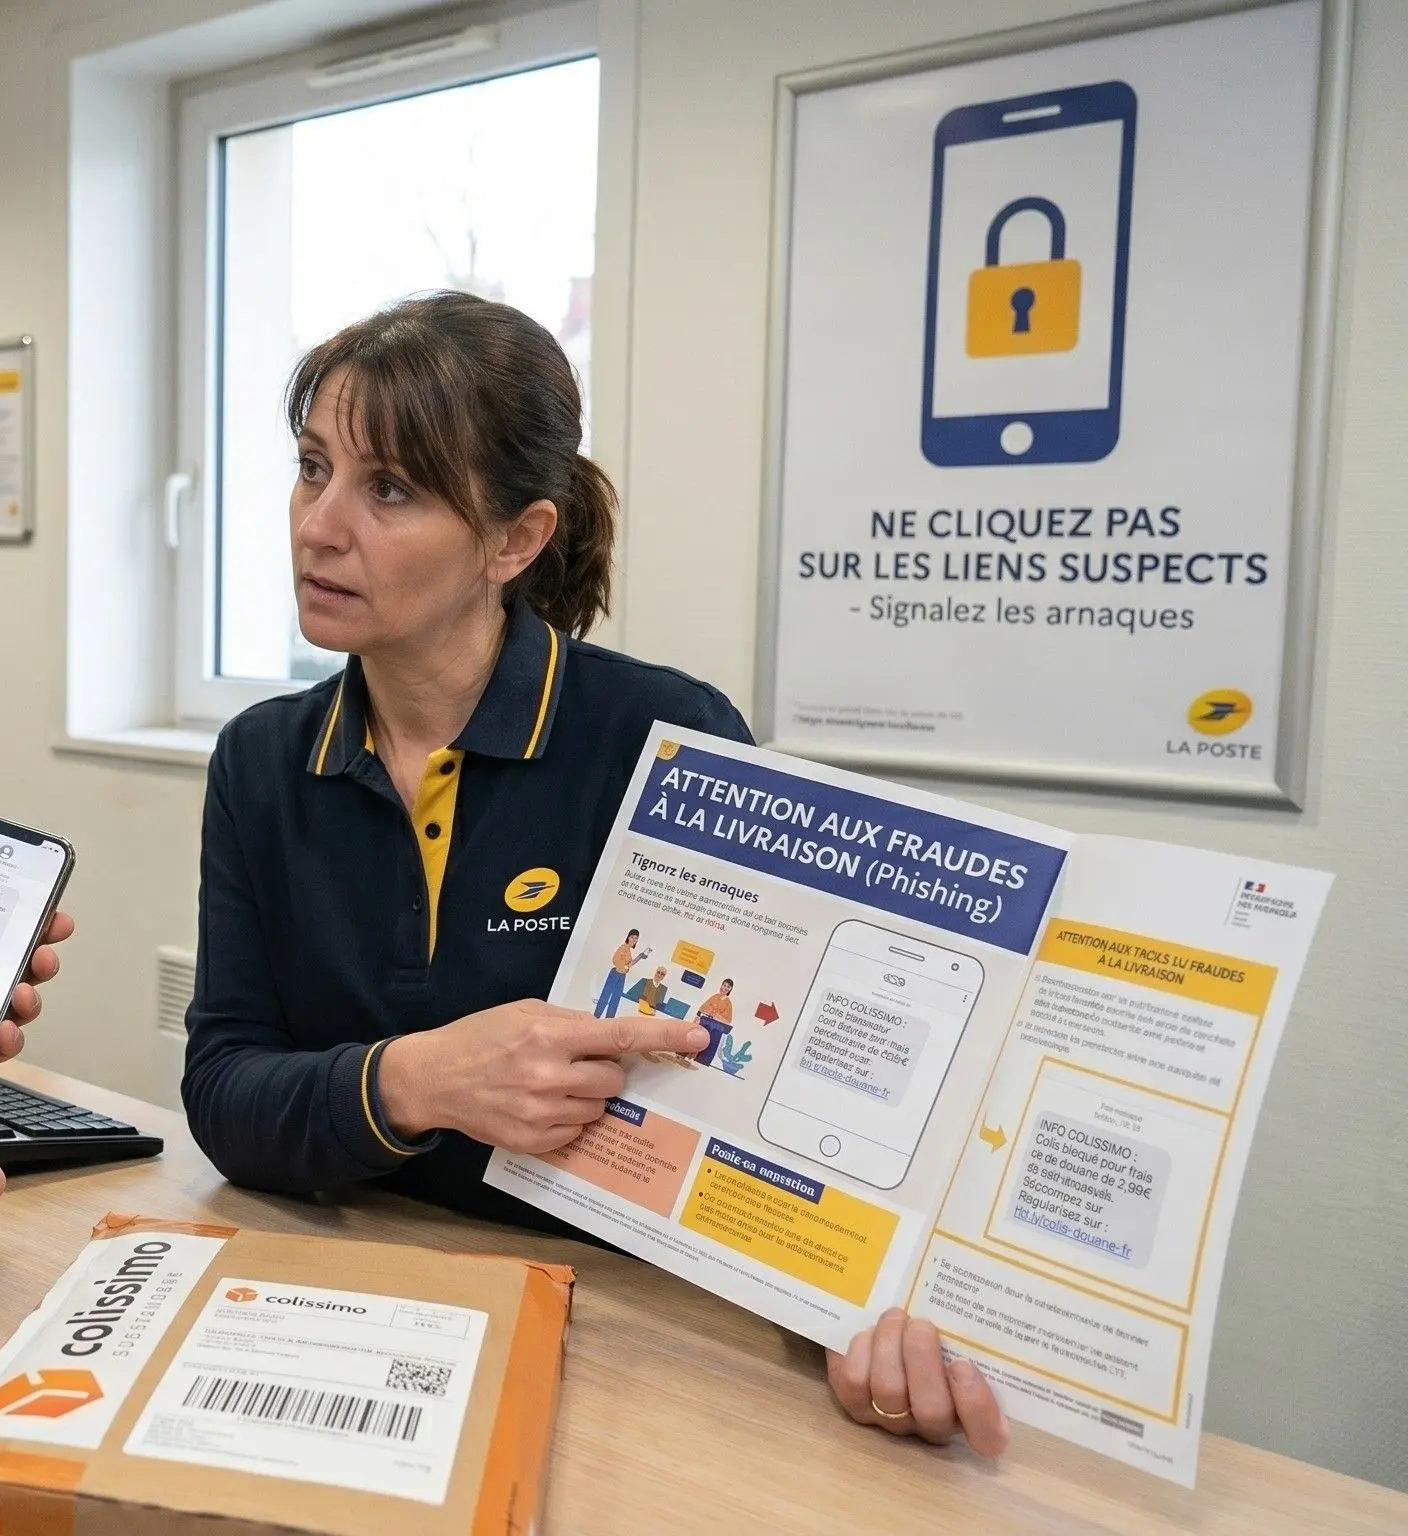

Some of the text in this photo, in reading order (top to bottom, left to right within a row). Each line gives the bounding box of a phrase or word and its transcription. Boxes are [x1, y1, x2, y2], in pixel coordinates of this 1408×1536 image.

[871, 506, 1181, 543] NE CLIQUEZ PAS
[799, 552, 1268, 584] SUR LES LIENS SUSPECTS
[869, 595, 986, 628] Signalez
[997, 598, 1036, 624] les
[1046, 605, 1194, 635] arnaques
[1167, 740, 1262, 760] LA POSTE
[661, 766, 1029, 890] ATTENTION AUX FRAUDES
[649, 791, 668, 821] À
[675, 806, 705, 831] LA
[713, 815, 861, 879] LIVRAISON
[865, 859, 1003, 924] (Phishing)
[632, 852, 676, 877] Tignorz
[679, 867, 697, 883] les
[699, 877, 760, 904] arnaques
[487, 916, 570, 932] LA POSTE
[1056, 931, 1109, 951] ATTENTION
[1108, 942, 1133, 956] AUX
[1190, 960, 1246, 984] FRAUDES
[1108, 957, 1122, 969] LA
[1124, 961, 1185, 985] LIVRAISON
[1035, 1134, 1061, 1151] Colis
[1100, 1157, 1127, 1173] pour
[1128, 1166, 1153, 1183] frais
[1040, 1119, 1066, 1137] INFO
[1068, 1129, 1132, 1159] COLISSIMO
[1044, 1153, 1058, 1166] de
[1060, 1159, 1099, 1180] douane
[1101, 1172, 1115, 1186] de
[1117, 1179, 1152, 1200] 2,99€
[1083, 1216, 1102, 1230] sur
[1084, 1201, 1104, 1214] sur
[61, 1241, 171, 1356] colissimo
[265, 1295, 367, 1315] colissimo
